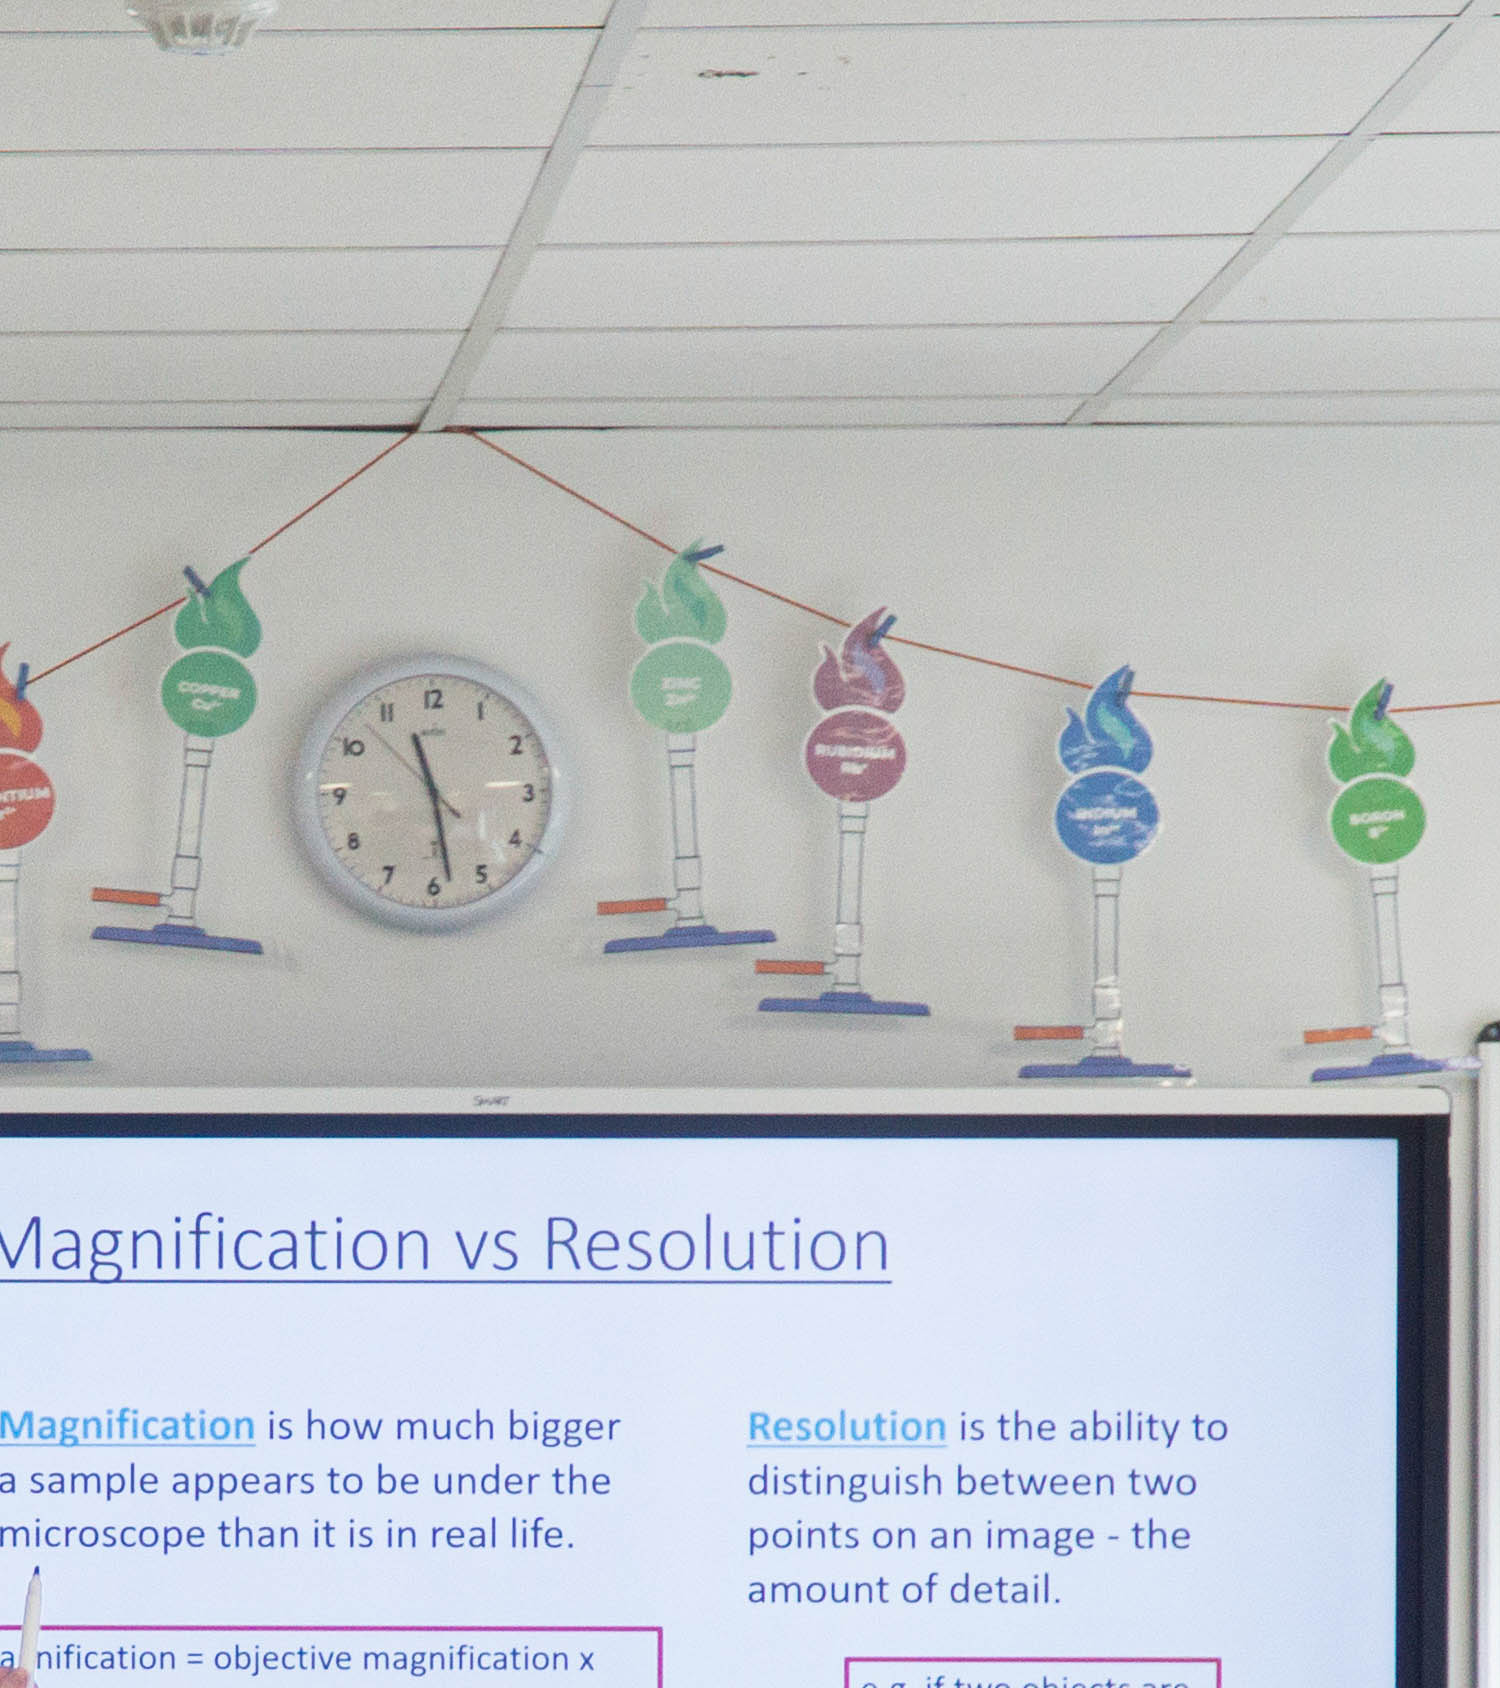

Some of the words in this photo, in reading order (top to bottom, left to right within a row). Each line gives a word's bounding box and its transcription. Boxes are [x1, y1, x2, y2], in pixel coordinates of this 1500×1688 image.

[177, 681, 242, 699] COPPER
[423, 689, 443, 709] 12
[381, 704, 393, 722] 11
[477, 702, 484, 721] 1
[343, 737, 365, 757] 10
[510, 736, 523, 755] 2
[333, 788, 346, 805] 9
[523, 783, 535, 802] 3
[348, 832, 359, 850] 8
[509, 829, 522, 847] 4
[382, 866, 395, 884] 7
[476, 865, 488, 883] 5
[428, 876, 440, 896] 6
[454, 1229, 519, 1272] vs
[546, 1213, 887, 1272] Resolution
[268, 1410, 294, 1441] is
[306, 1408, 384, 1441] how
[396, 1408, 495, 1441] much
[509, 1408, 622, 1449] bigger
[747, 1409, 947, 1444] Resolution
[960, 1411, 985, 1442] is
[996, 1409, 1056, 1442] the
[1069, 1409, 1181, 1449] ability
[1191, 1413, 1229, 1442] to
[29, 1462, 159, 1502] sample
[171, 1472, 315, 1502] appears
[326, 1467, 364, 1495] to
[377, 1462, 420, 1495] be
[433, 1463, 541, 1496] under
[551, 1463, 611, 1496] the
[748, 1463, 942, 1504] distinguish
[956, 1463, 1115, 1497] between
[1127, 1468, 1198, 1497] two
[217, 1515, 299, 1549] than
[313, 1518, 336, 1549] it
[349, 1518, 374, 1549] is
[387, 1518, 417, 1549] in
[431, 1516, 497, 1549] real
[511, 1516, 574, 1549] life.
[748, 1519, 860, 1557] points
[871, 1527, 917, 1550] on
[930, 1527, 972, 1550] an
[986, 1519, 1095, 1558] image
[1130, 1517, 1191, 1551] the
[747, 1576, 889, 1604] amount
[901, 1571, 939, 1604] of
[949, 1571, 1061, 1605] detail.
[213, 1643, 352, 1678] objective
[363, 1643, 569, 1678] magnification
[579, 1651, 595, 1671] x
